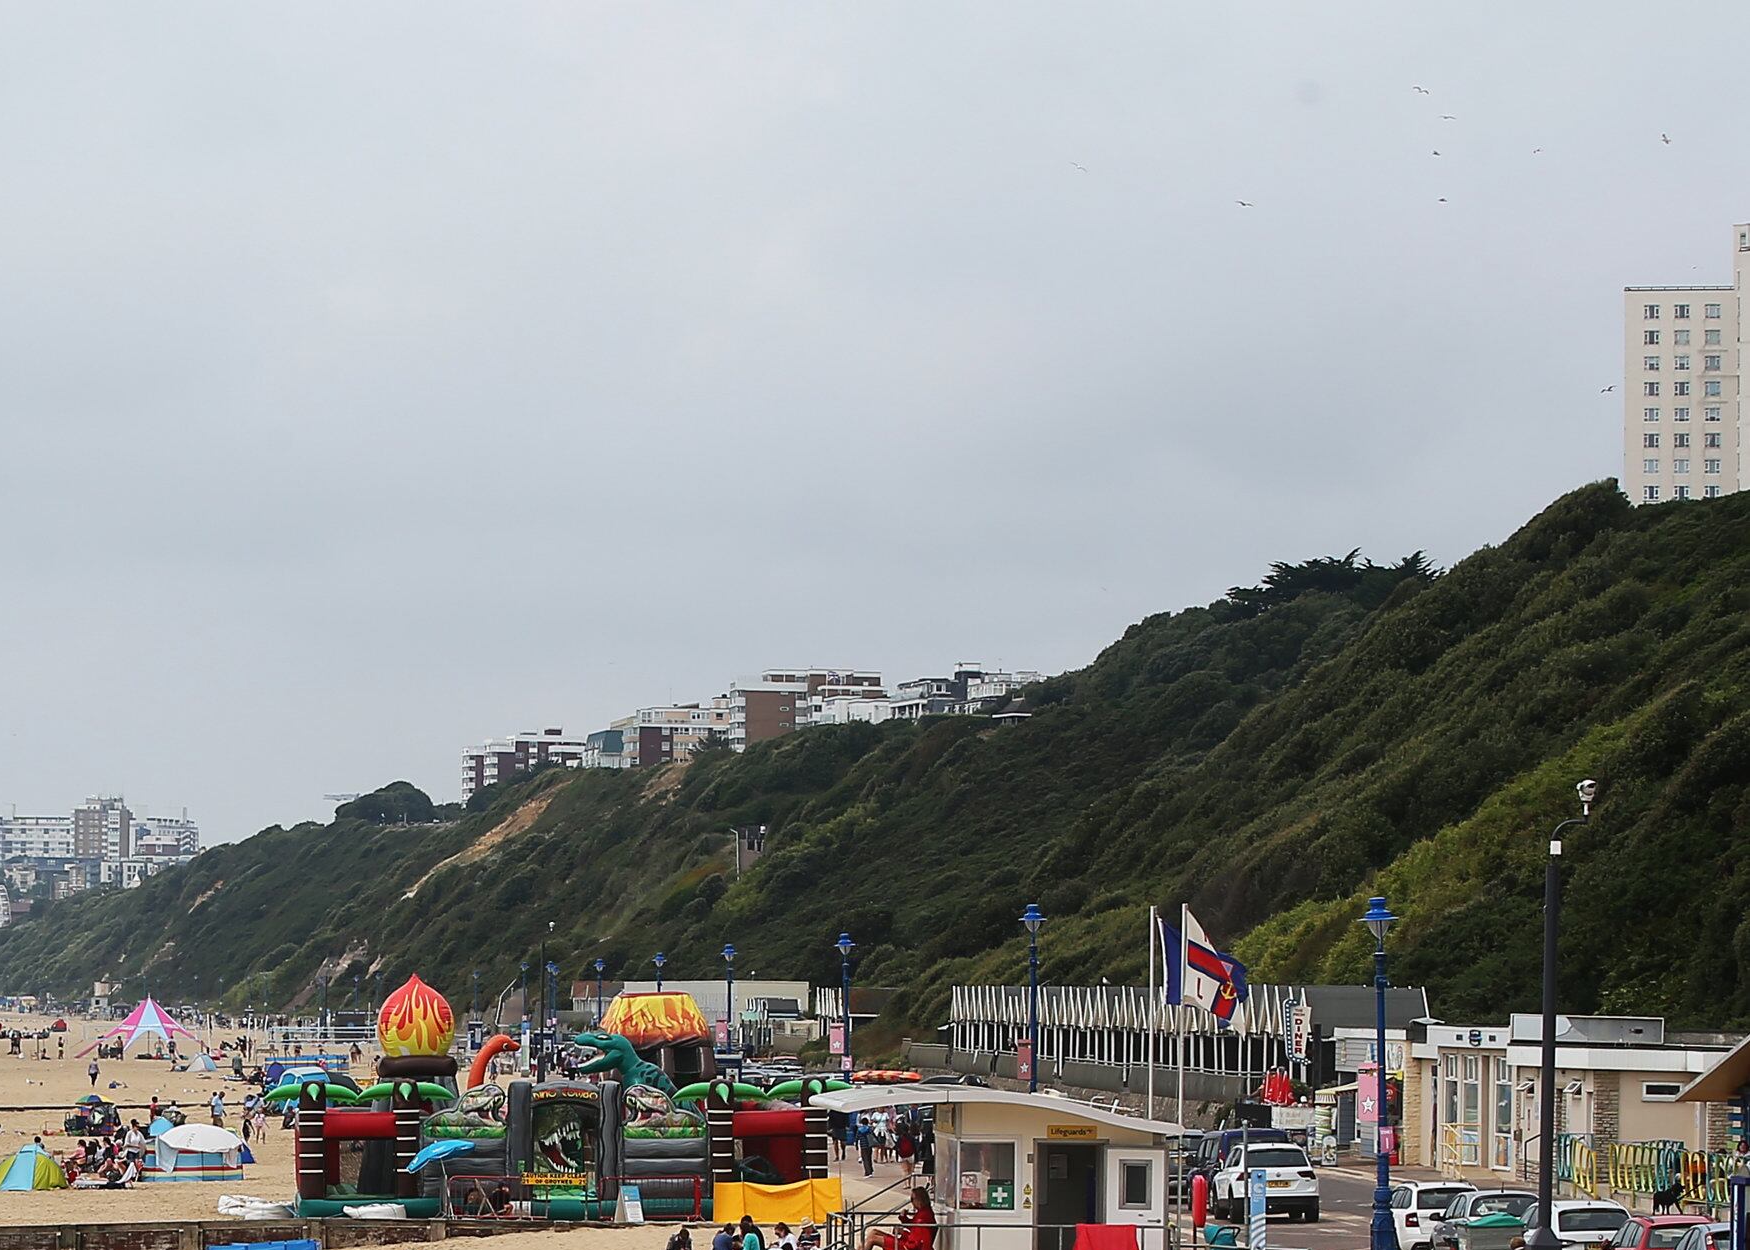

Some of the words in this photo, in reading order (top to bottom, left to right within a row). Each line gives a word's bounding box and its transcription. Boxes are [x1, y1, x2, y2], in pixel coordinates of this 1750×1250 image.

[1196, 976, 1204, 1000] L
[1294, 1018, 1304, 1054] DINER
[532, 1088, 558, 1100] DINO
[1050, 1128, 1087, 1137] Lifeguards
